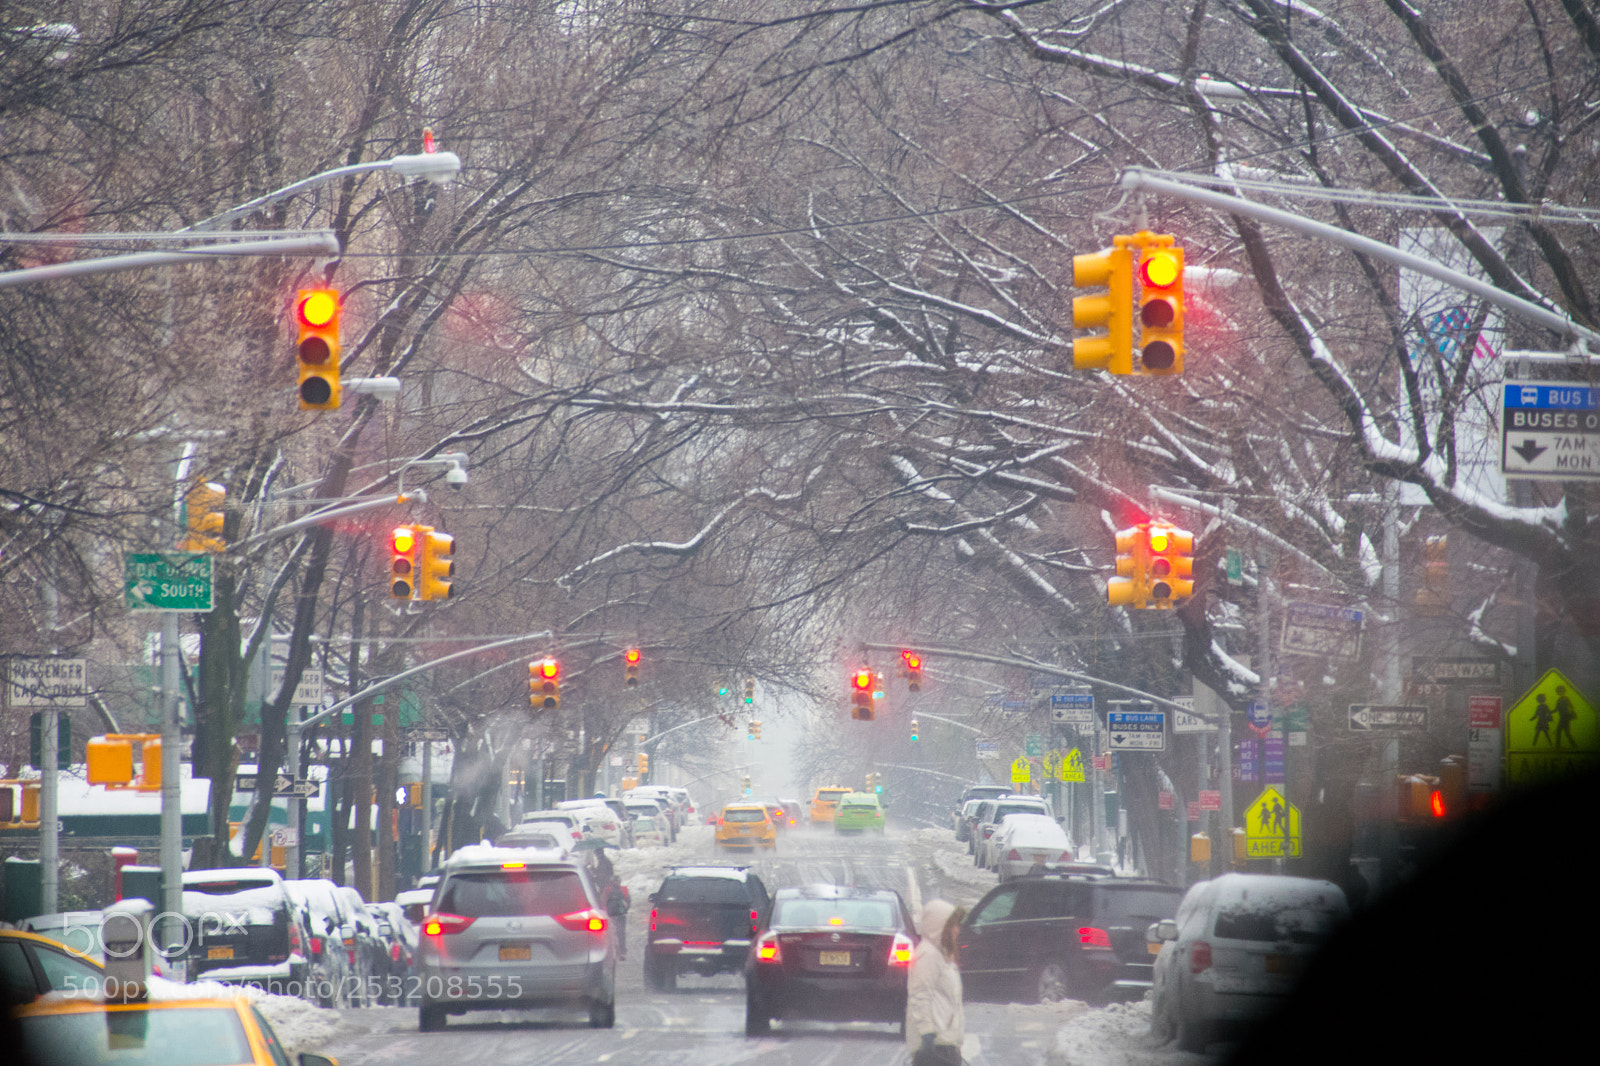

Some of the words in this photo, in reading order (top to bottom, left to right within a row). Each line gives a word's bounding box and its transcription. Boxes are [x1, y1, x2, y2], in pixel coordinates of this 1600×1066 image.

[1548, 390, 1582, 405] BUS
[1588, 391, 1600, 405] L
[1513, 412, 1578, 428] BUSES
[1585, 414, 1600, 428] O
[1553, 437, 1586, 451] 7AM
[1556, 455, 1592, 469] MON
[160, 583, 204, 598] SOUTH
[13, 663, 82, 679] PASSENGER
[273, 673, 320, 685] PAGER
[299, 688, 320, 699] ONLY
[1176, 715, 1198, 726] CARS
[1360, 712, 1383, 723] ONE
[1400, 712, 1422, 724] WAY
